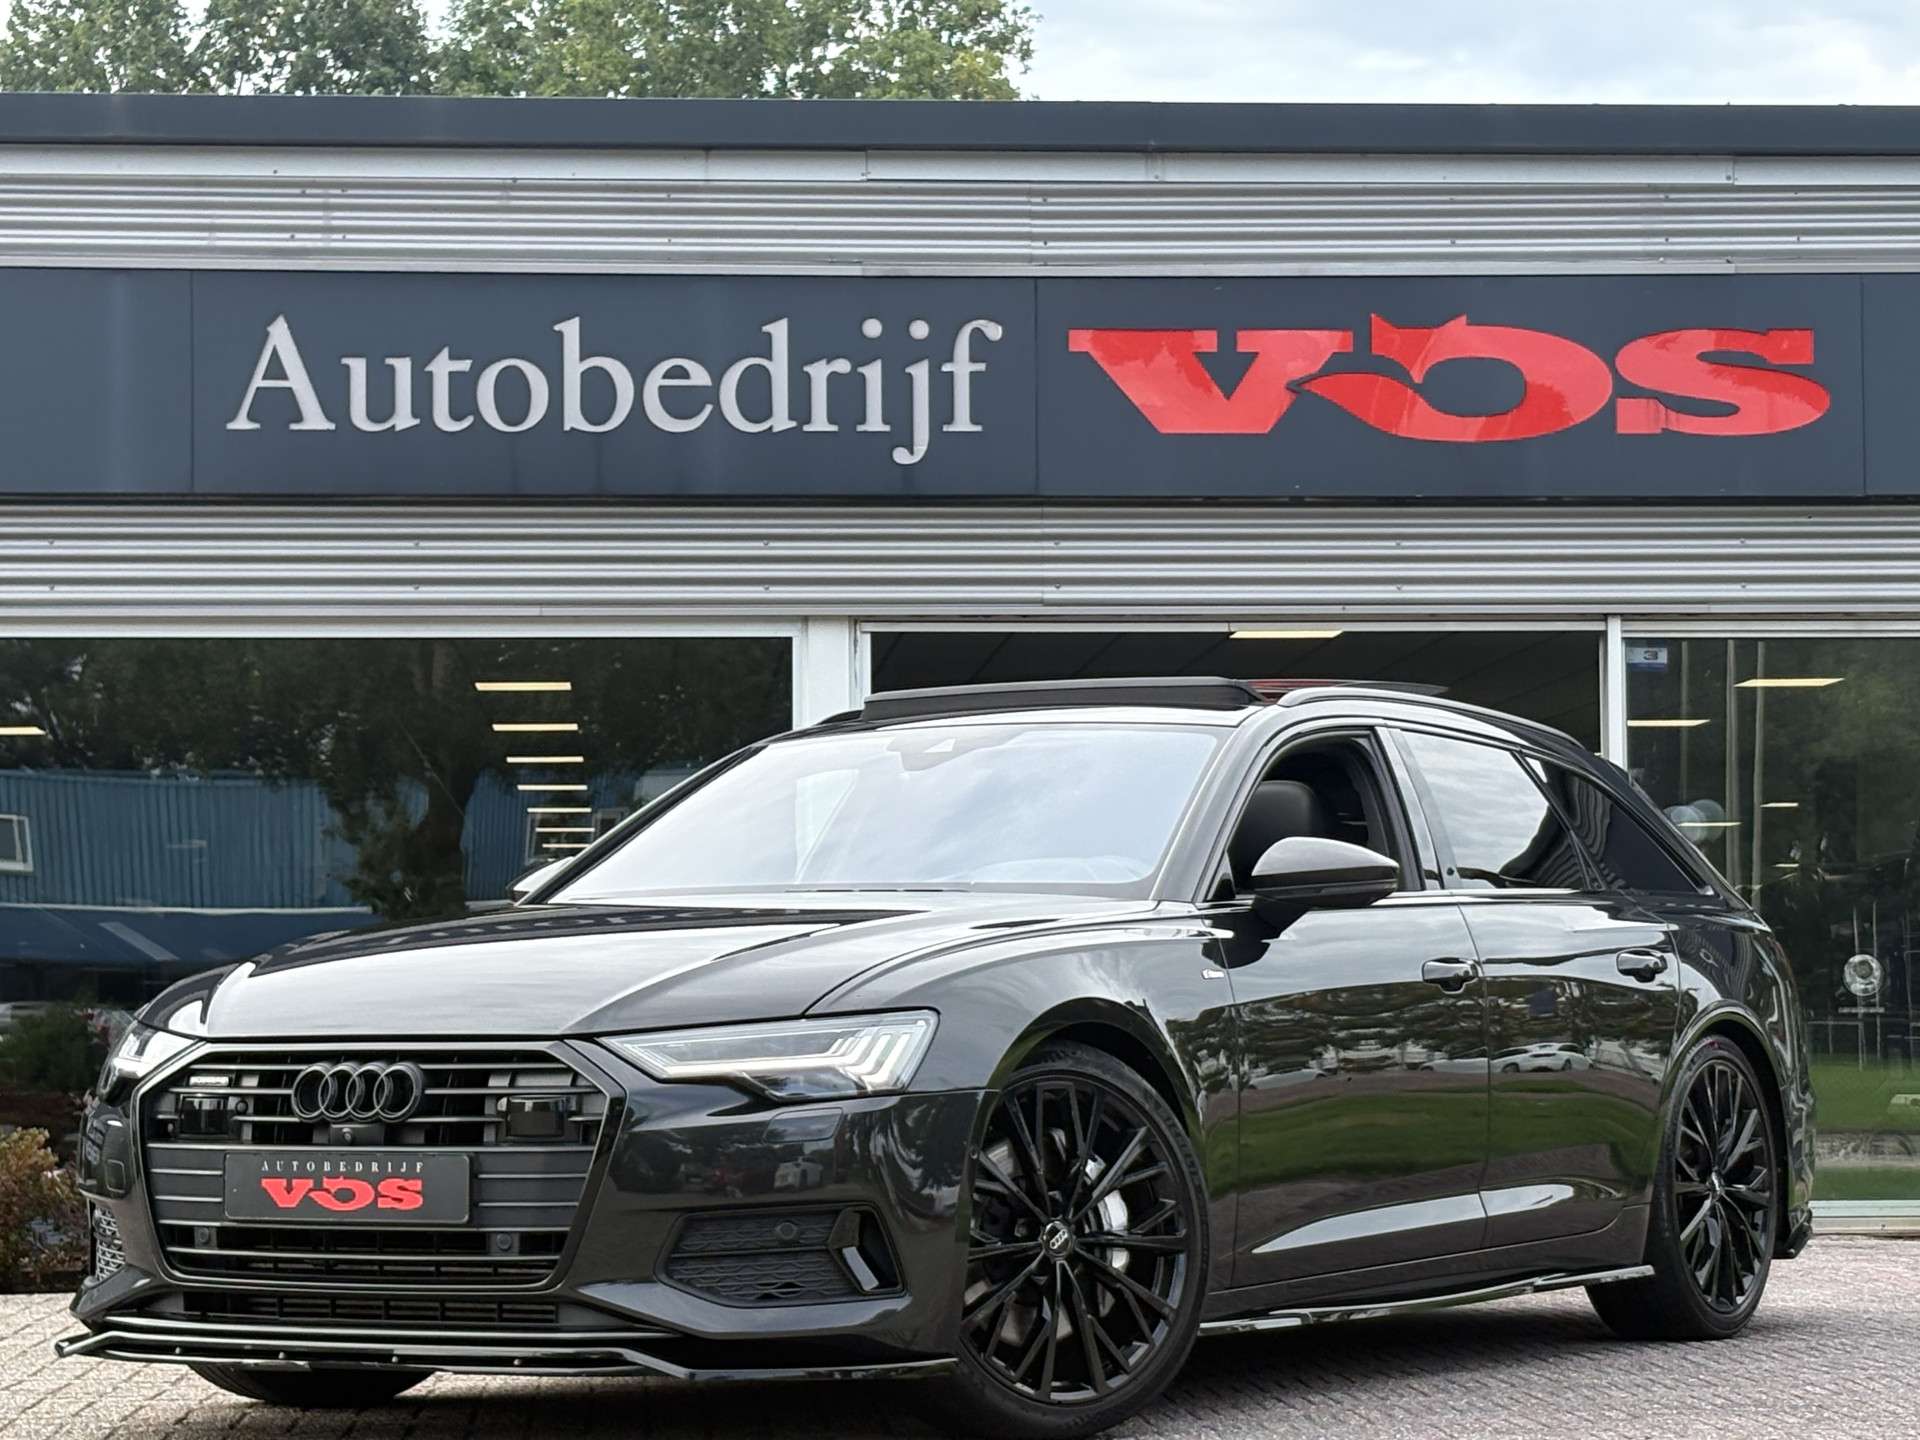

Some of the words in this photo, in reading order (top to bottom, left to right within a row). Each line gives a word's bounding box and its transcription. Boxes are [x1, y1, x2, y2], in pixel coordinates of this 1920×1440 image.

[226, 315, 1003, 466] Autobedrijf
[1068, 313, 1832, 443] VOS
[261, 1160, 424, 1173] AUTOBEDRIJF
[260, 1175, 424, 1211] VOS
